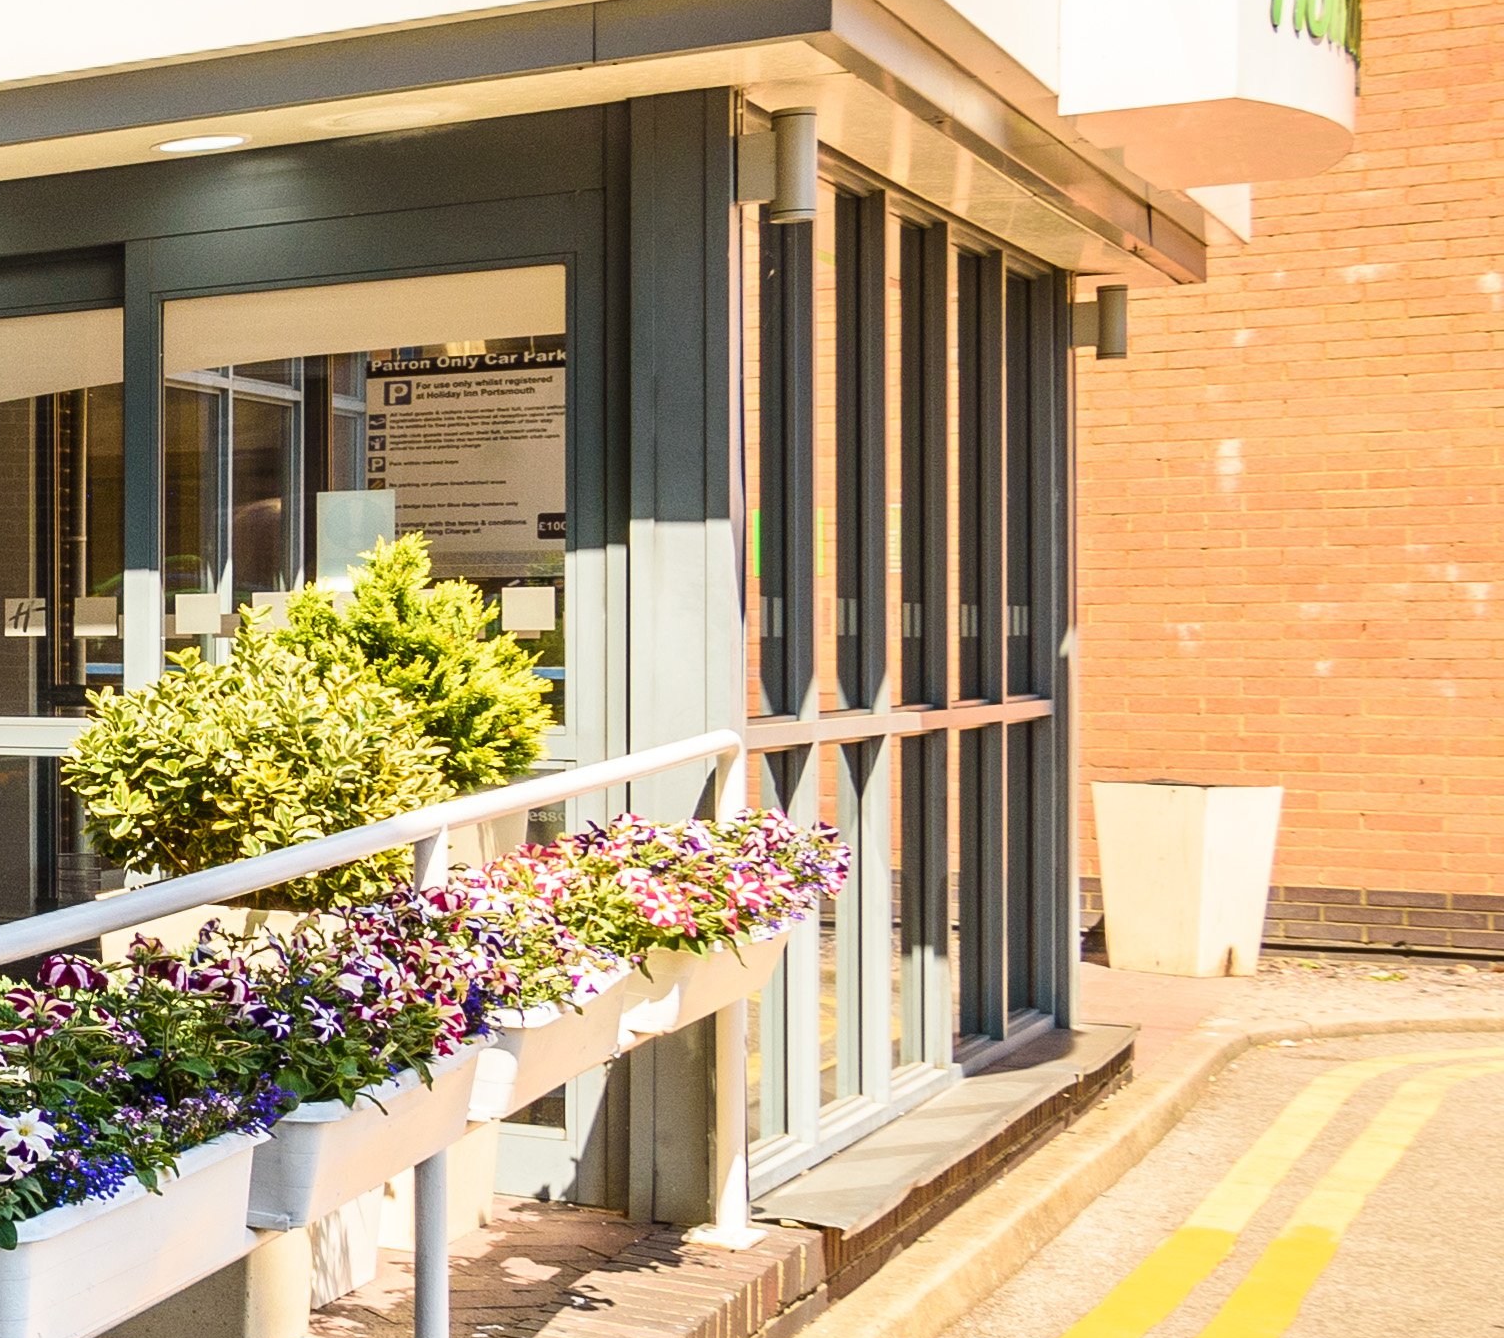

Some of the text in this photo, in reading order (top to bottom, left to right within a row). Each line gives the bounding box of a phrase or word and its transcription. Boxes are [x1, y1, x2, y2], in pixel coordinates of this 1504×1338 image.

[371, 349, 566, 372] Patron Only Car Park
[453, 380, 472, 389] only
[475, 378, 502, 387] whilst
[505, 375, 553, 386] registered
[416, 387, 535, 400] at Holiday Inn Portsmouth
